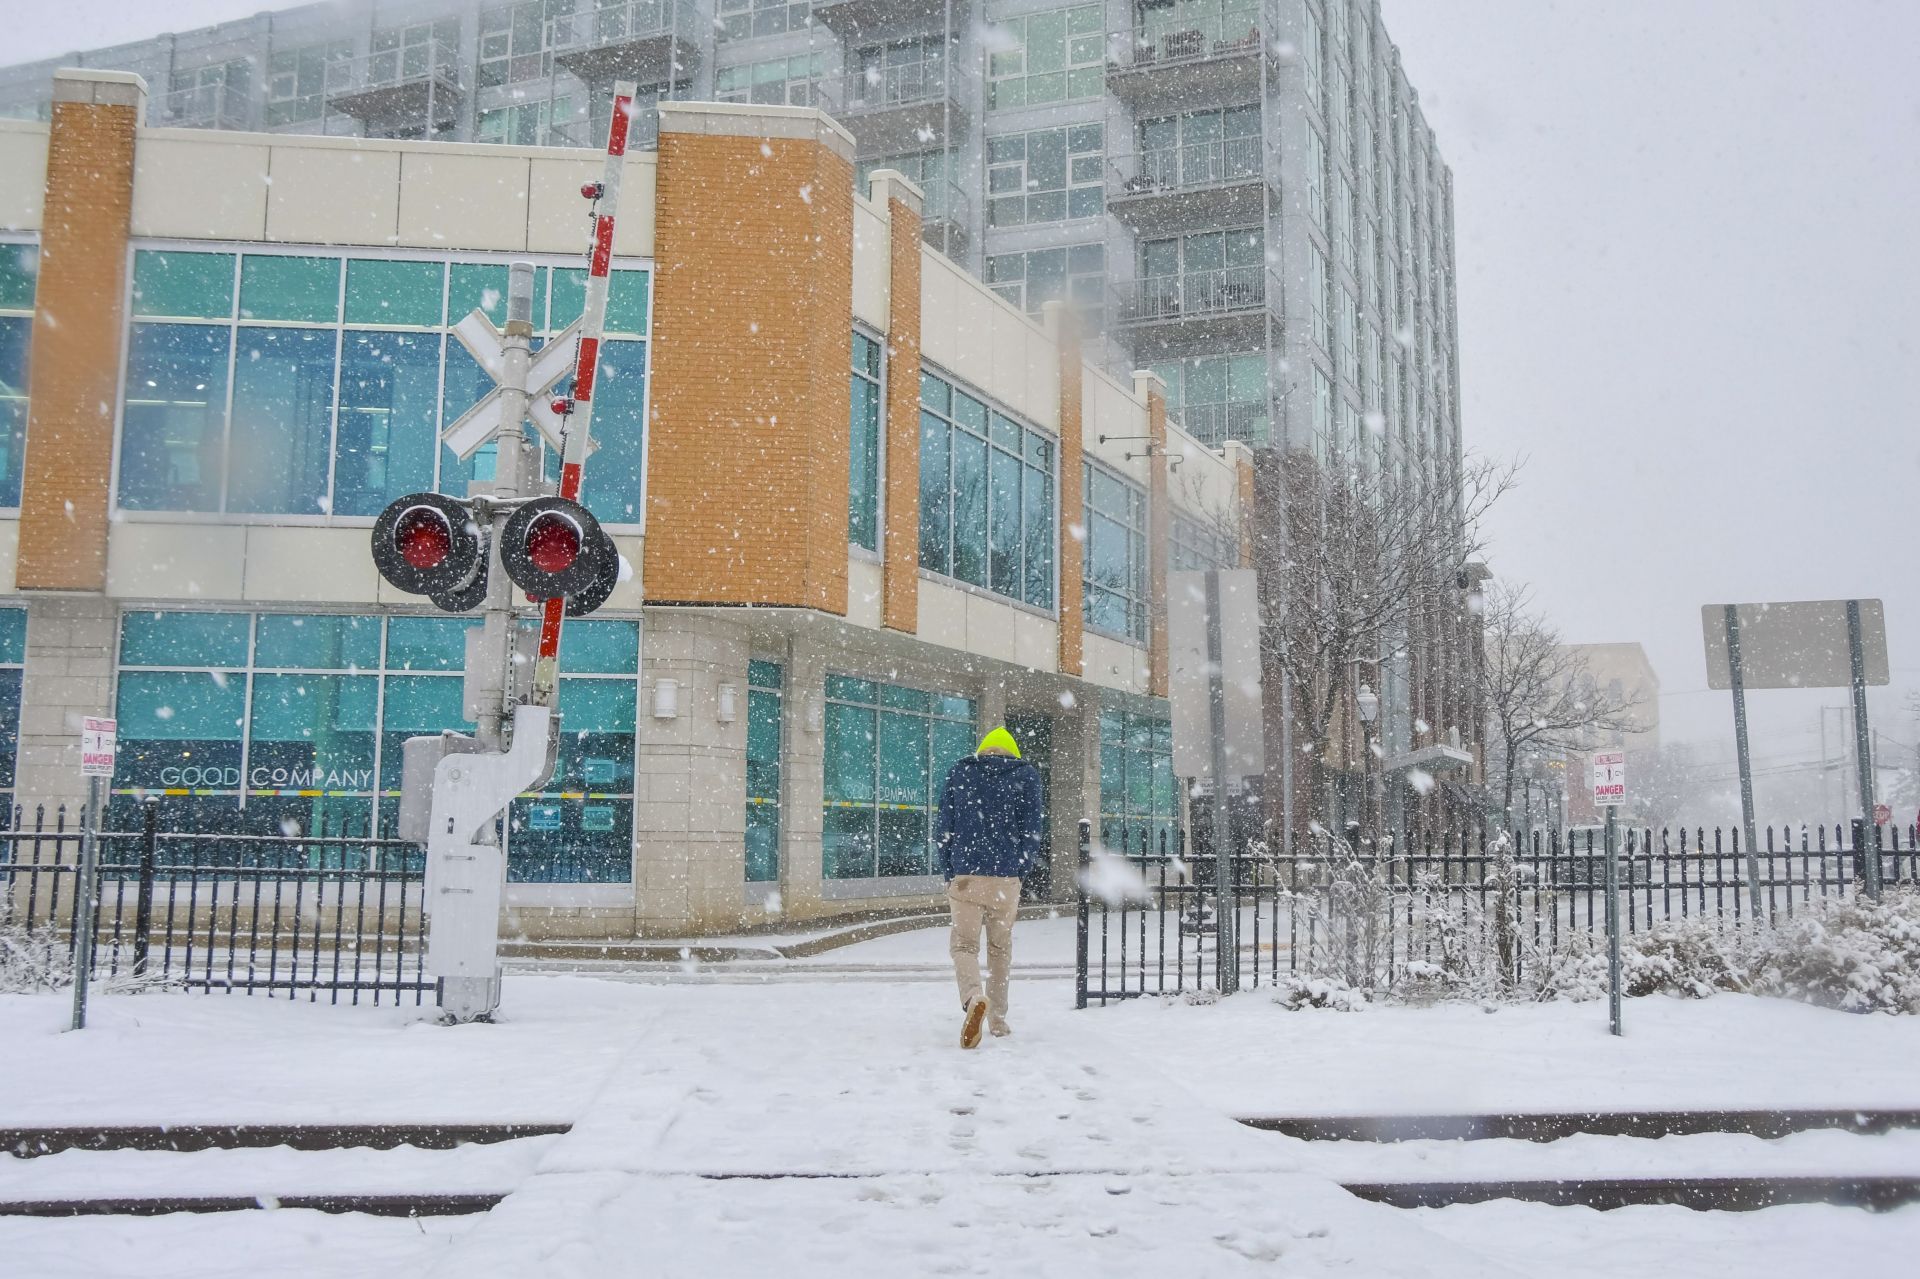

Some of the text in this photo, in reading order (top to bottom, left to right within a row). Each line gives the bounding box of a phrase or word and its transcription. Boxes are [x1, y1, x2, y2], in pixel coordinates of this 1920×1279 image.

[83, 752, 113, 765] DANGER
[160, 766, 373, 787] GOOD COMPANY
[1595, 784, 1624, 795] DANGER
